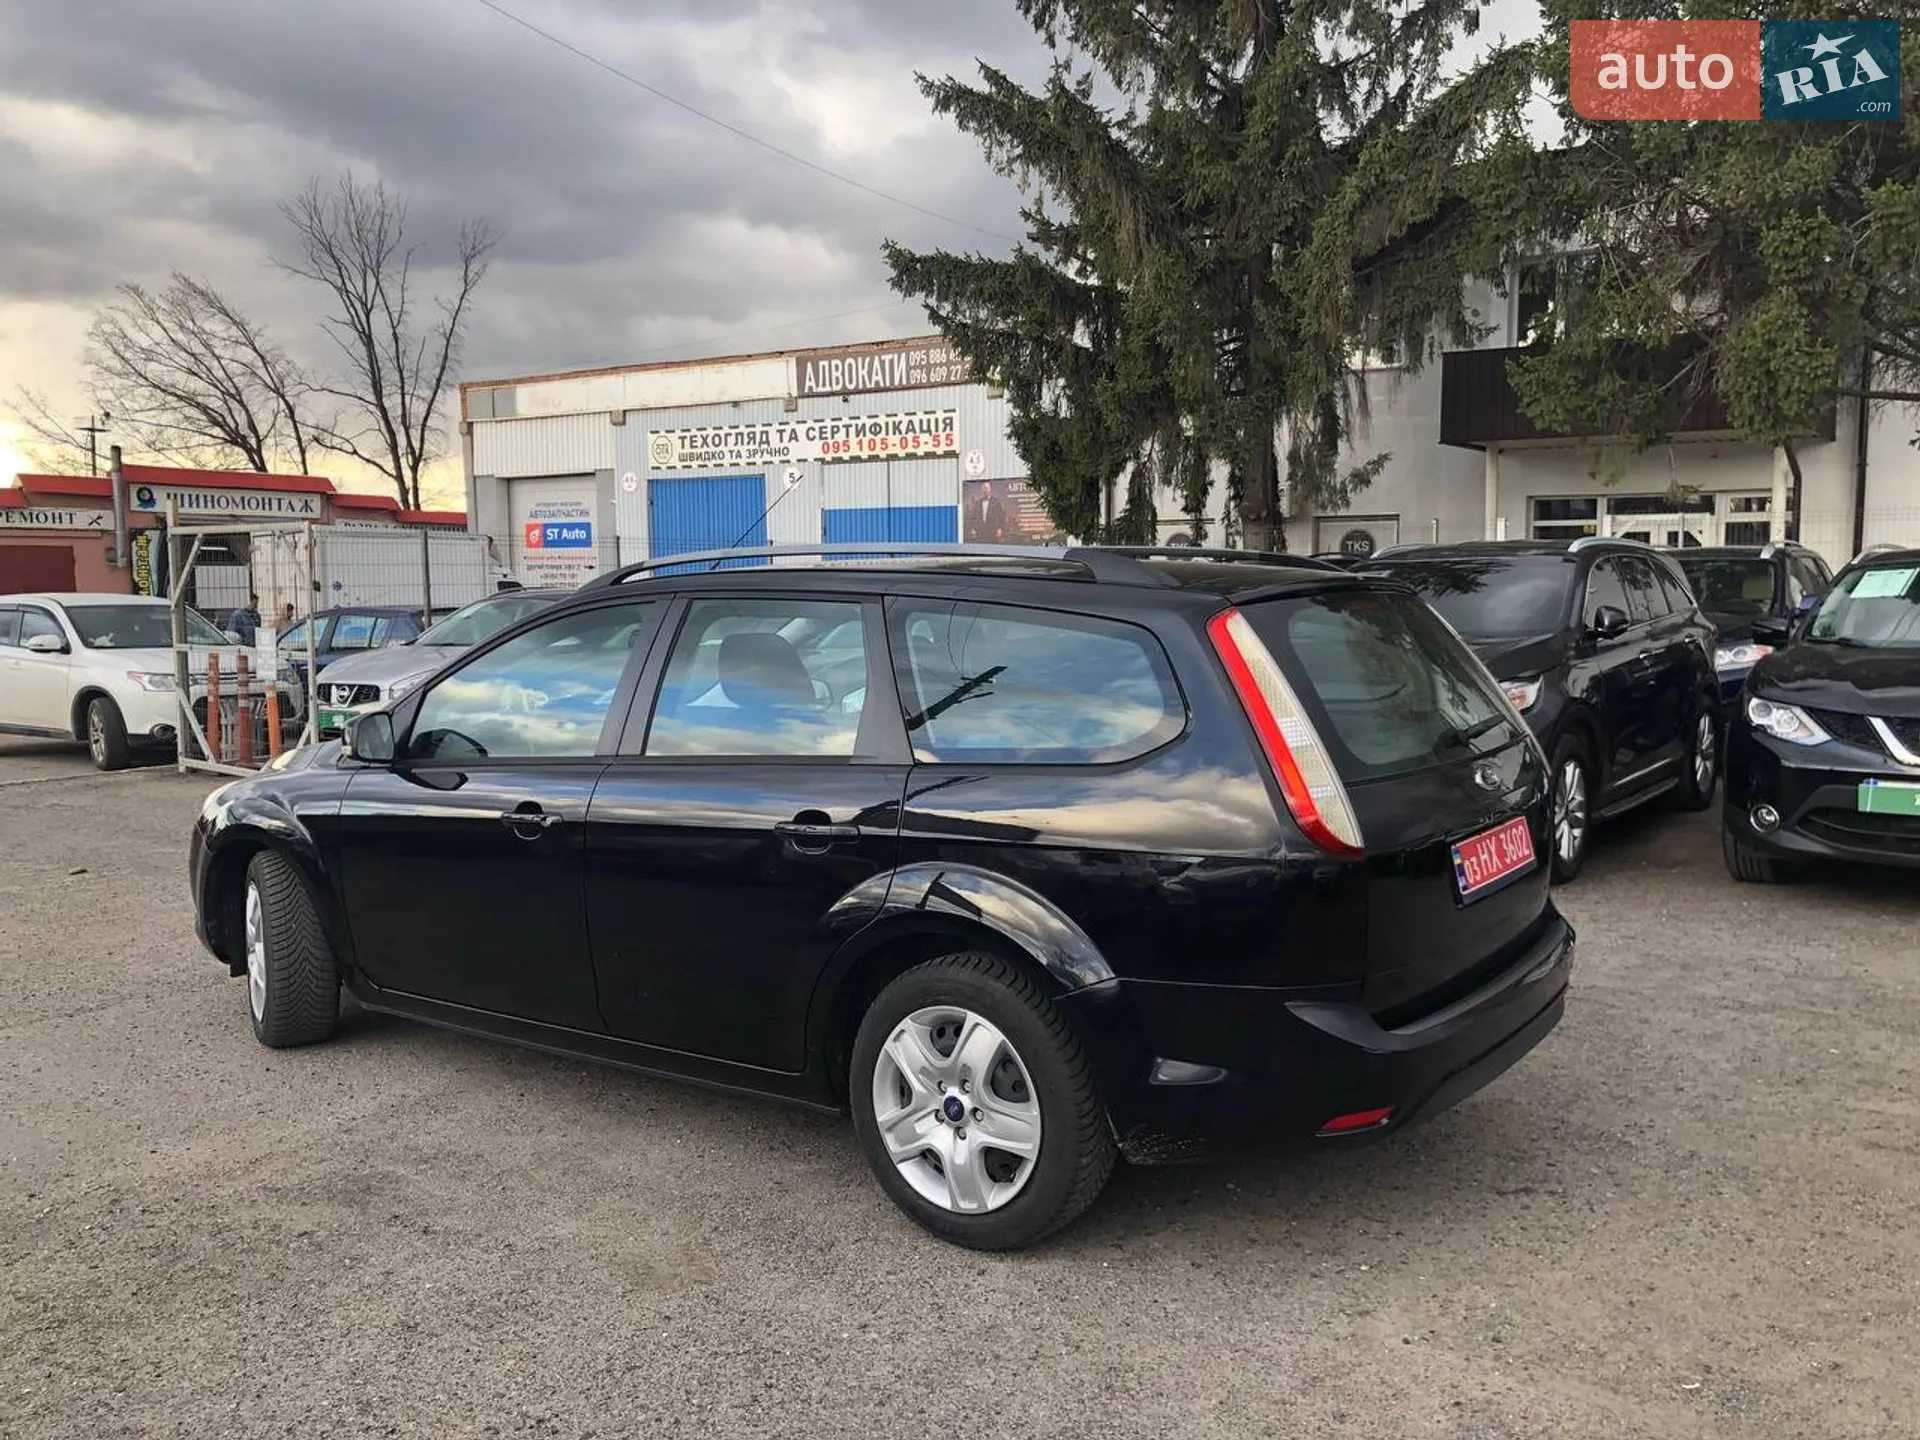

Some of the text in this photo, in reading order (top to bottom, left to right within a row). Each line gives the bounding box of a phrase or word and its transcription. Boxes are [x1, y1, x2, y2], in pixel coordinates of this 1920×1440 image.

[909, 349, 928, 366] 095
[929, 348, 947, 364] 886
[804, 352, 907, 393] АДВОКАТИ
[909, 368, 928, 385] 096
[930, 366, 948, 382] 609
[950, 364, 961, 381] 27
[678, 416, 954, 450] ТЕХОГЛЯД ТА СЕРТИФІКАЦІЯ
[678, 446, 790, 462] ШВИДКО ТА ЗРУЧНО
[822, 440, 850, 455] 095
[0, 509, 77, 526] ЕМОНТ
[546, 528, 587, 540] ST Auto
[1346, 540, 1370, 552] TKS
[1464, 825, 1530, 884] 03 HX 3602
